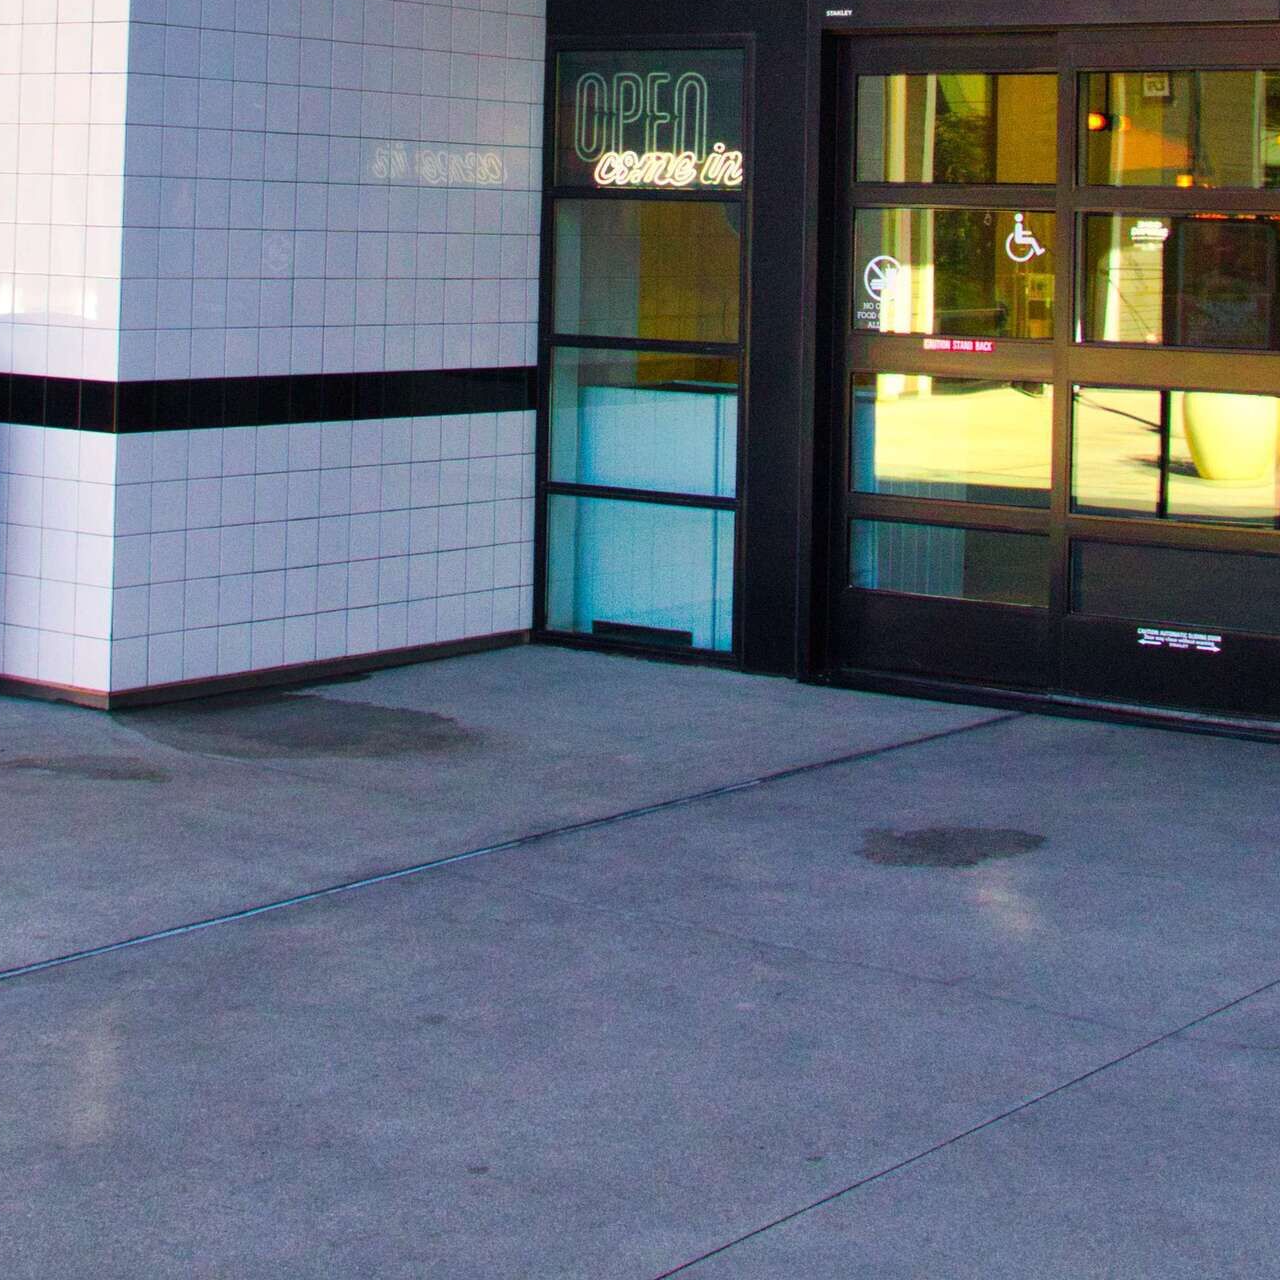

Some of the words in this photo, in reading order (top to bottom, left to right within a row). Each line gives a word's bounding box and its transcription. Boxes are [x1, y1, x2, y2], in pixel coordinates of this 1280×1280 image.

[575, 72, 708, 163] OPEN
[594, 150, 697, 186] come
[700, 142, 743, 186] in
[857, 311, 876, 319] FOOD
